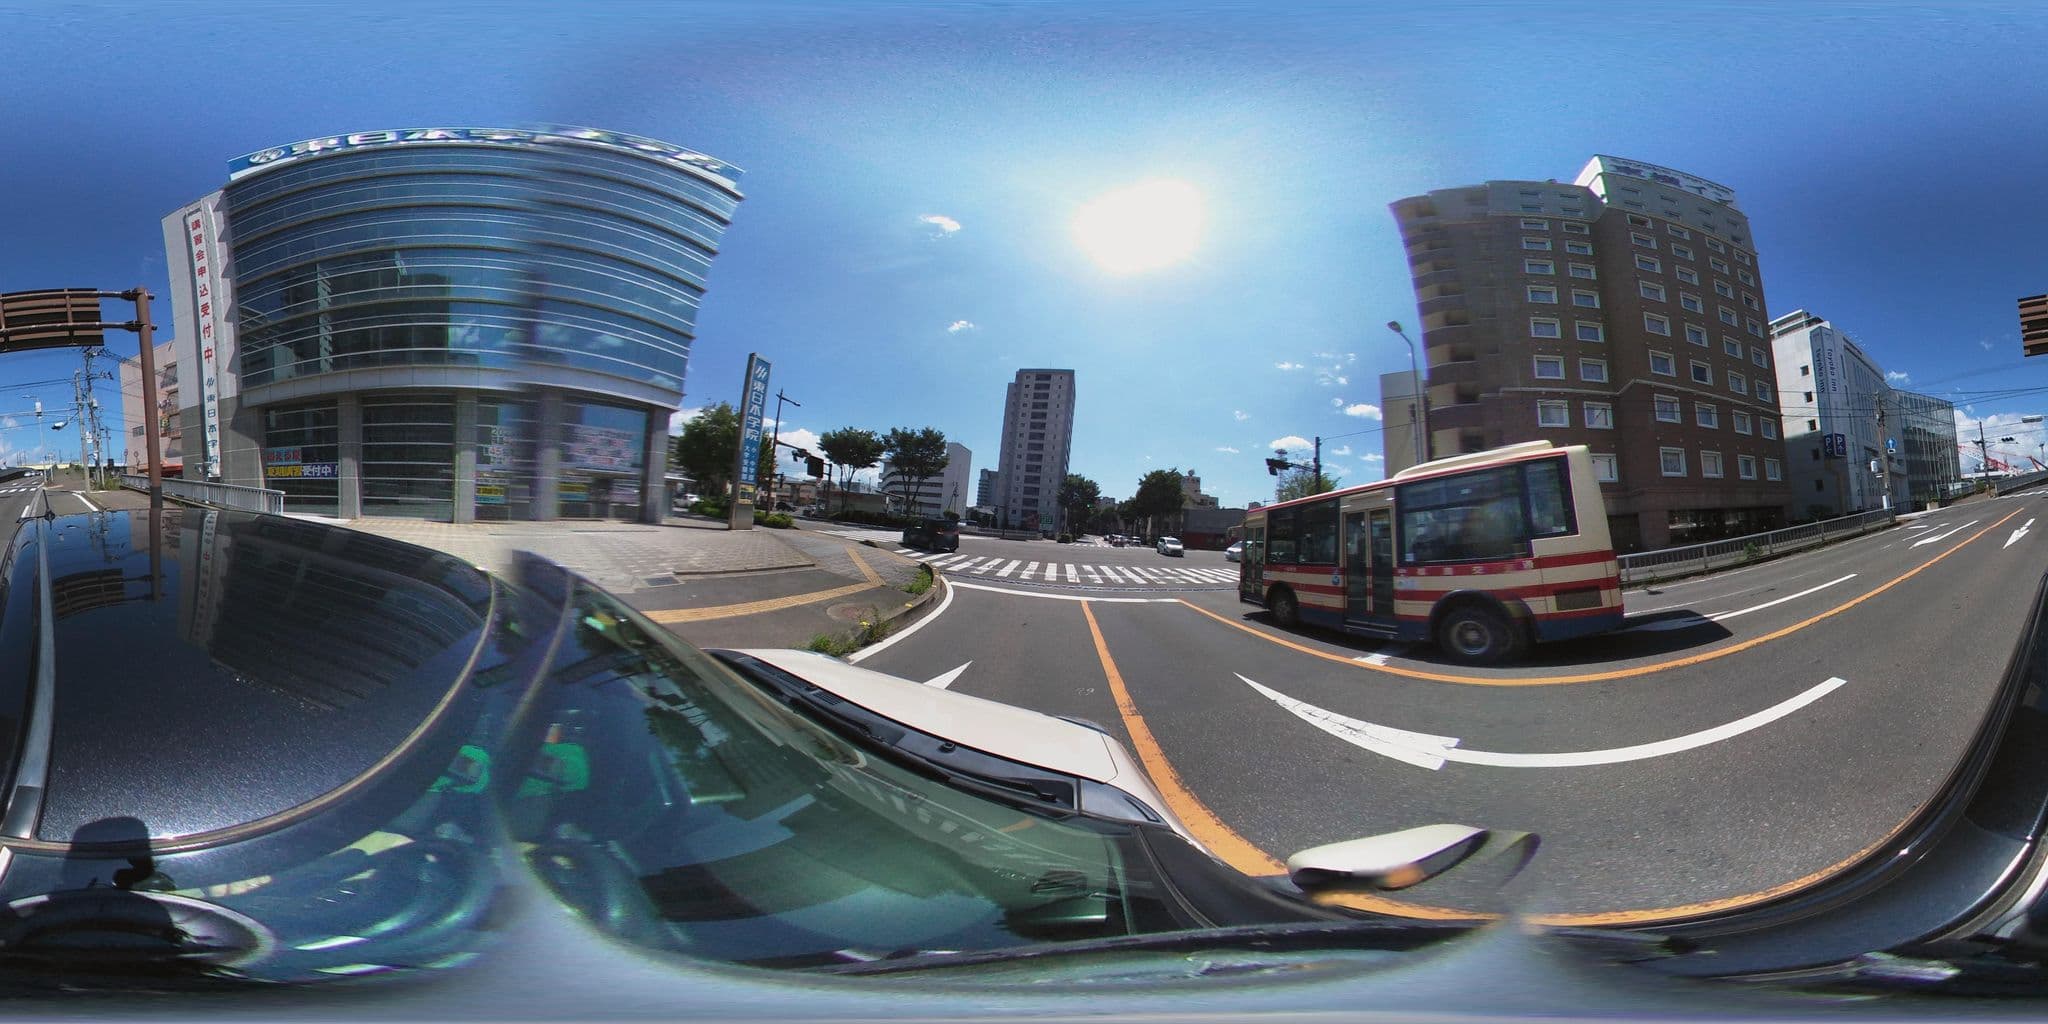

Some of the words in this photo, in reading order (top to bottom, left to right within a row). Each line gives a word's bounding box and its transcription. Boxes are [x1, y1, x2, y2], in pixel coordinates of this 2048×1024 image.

[745, 380, 766, 442] 東日本学院
[1836, 436, 1843, 445] P
